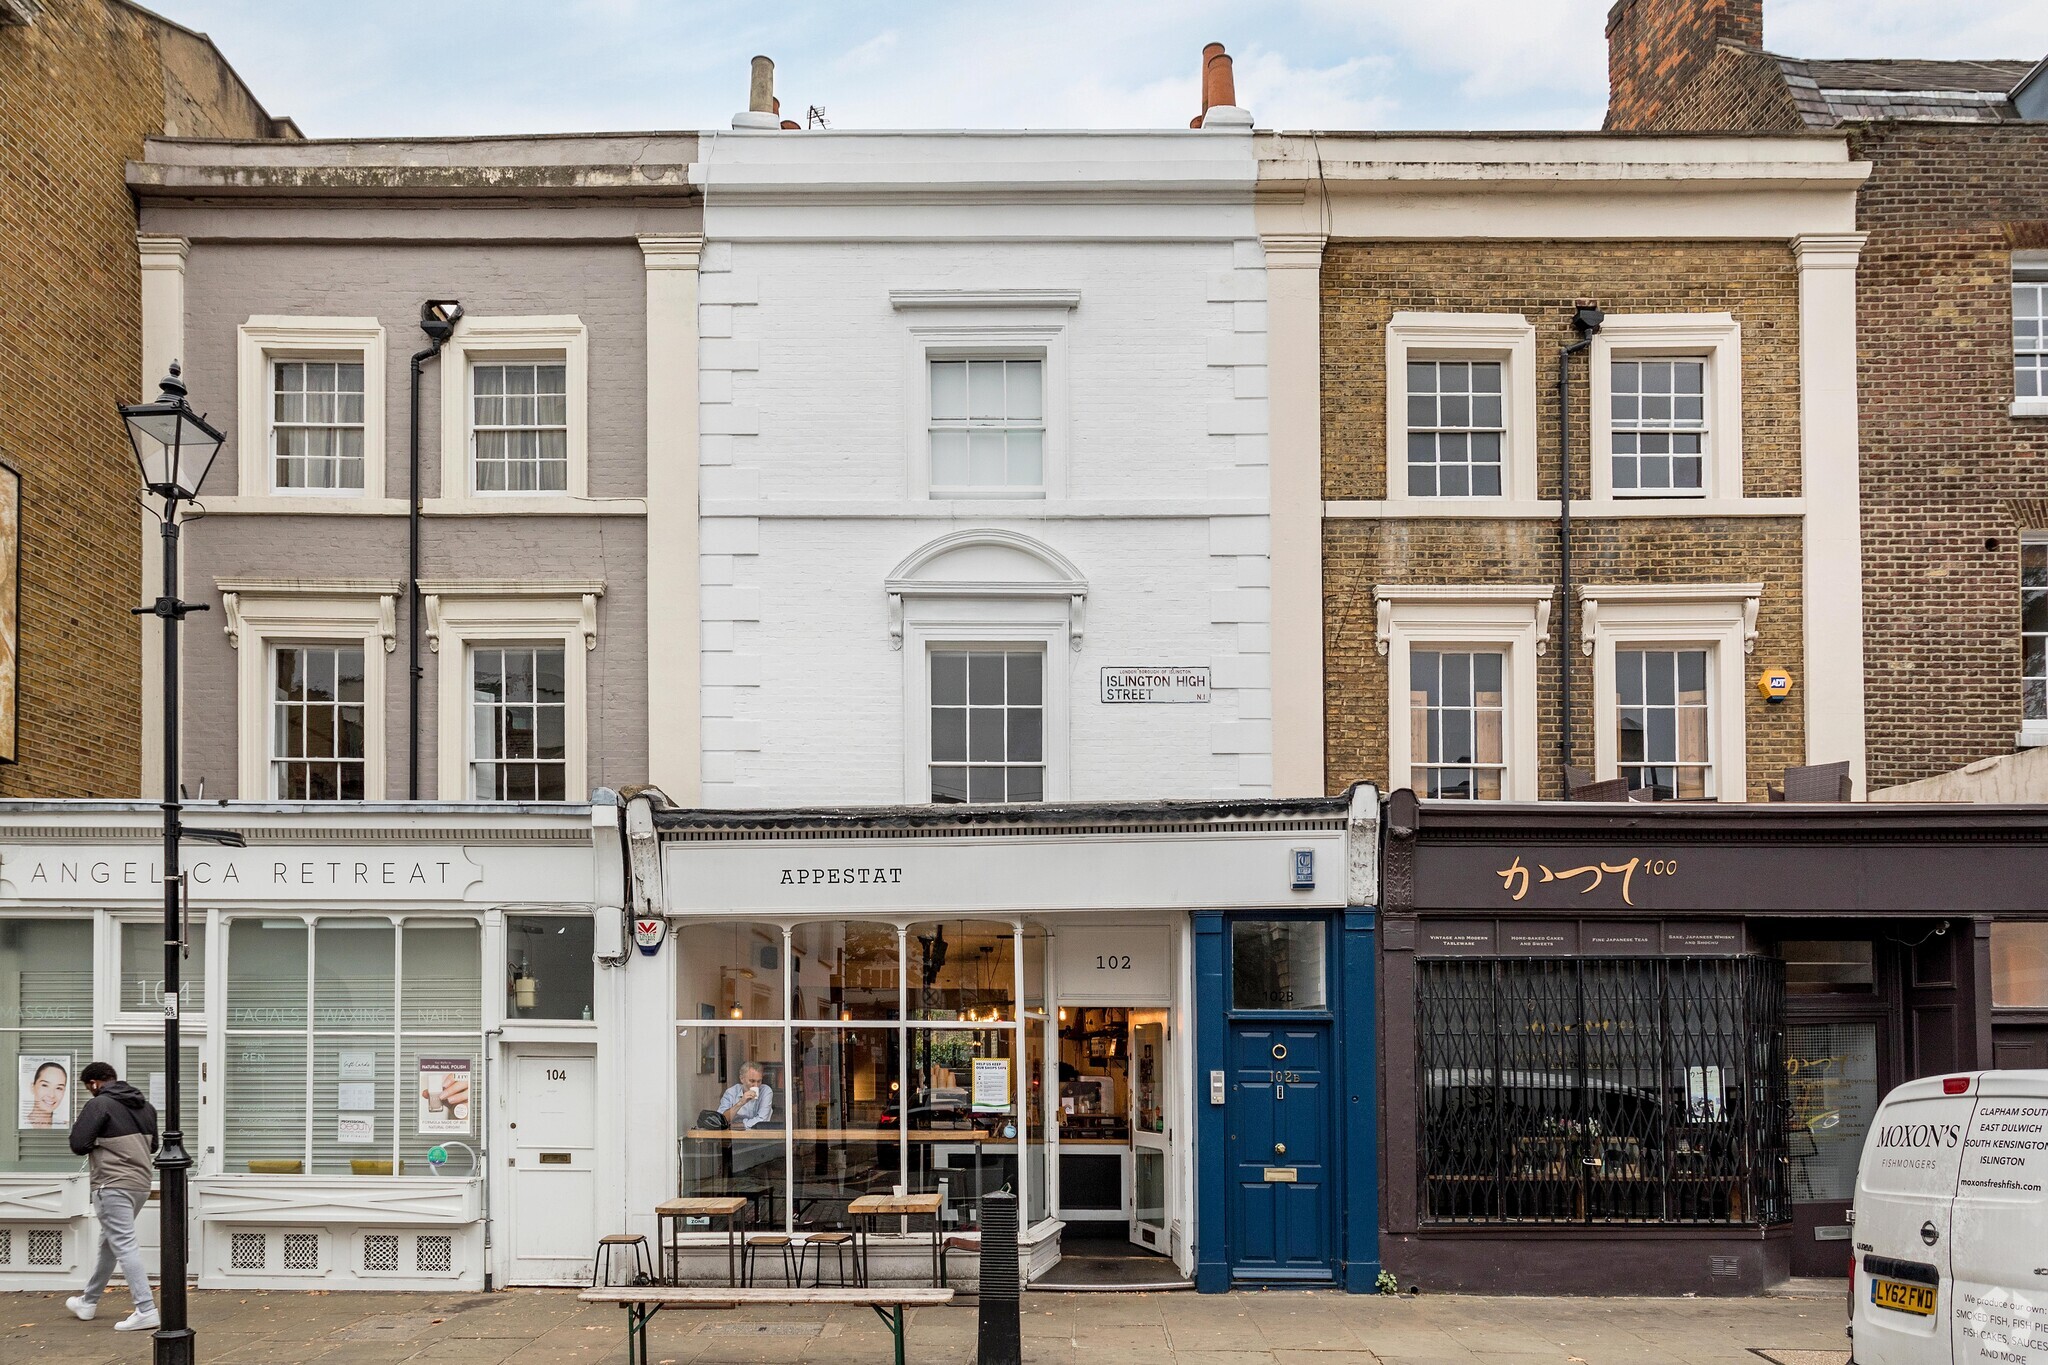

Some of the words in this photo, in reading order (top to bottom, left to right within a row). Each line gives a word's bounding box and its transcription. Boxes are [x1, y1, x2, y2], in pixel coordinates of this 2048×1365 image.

[1106, 676, 1171, 687] ISLINGTON
[1176, 676, 1206, 687] HIGH
[1771, 679, 1786, 687] ADT
[1106, 689, 1154, 700] STREET
[31, 862, 240, 884] ANGELCA
[273, 862, 451, 884] RETREAT
[1643, 859, 1677, 876] 100
[780, 868, 902, 885] APPESTAT
[1096, 955, 1131, 970] 102
[1263, 991, 1294, 1002] 102B
[1, 1006, 75, 1020] MASSAGE
[235, 1008, 301, 1023] FACIALS
[323, 1008, 388, 1023] WAXING
[417, 1009, 464, 1024] NAILS
[242, 1052, 265, 1062] REN
[546, 1069, 567, 1081] 104
[1980, 1108, 2020, 1116] CLAPHAM
[1980, 1123, 2000, 1132] EAST
[2001, 1124, 2042, 1133] DULWICH
[1877, 1124, 1961, 1148] MOXON'S
[1965, 1139, 1991, 1148] SOUTH
[1881, 1158, 1936, 1170] FISHMONGERS
[1980, 1156, 2026, 1166] ISLINGTON
[1960, 1179, 2042, 1192] moxonsfreshfish.com
[1877, 1282, 1907, 1305] LY62
[1908, 1287, 1934, 1309] FWD
[1964, 1293, 1976, 1304] We
[1976, 1297, 2008, 1309] produce
[2009, 1302, 2023, 1311] our
[2026, 1306, 2047, 1315] own:
[1956, 1309, 1988, 1323] SMOKED
[1989, 1314, 2011, 1328] FISH,
[2012, 1318, 2032, 1329] FISH
[1963, 1327, 1979, 1338] FISH
[1980, 1330, 2010, 1345] CAKES,
[1980, 1348, 1999, 1359] AND
[2000, 1351, 2027, 1365] MORE
